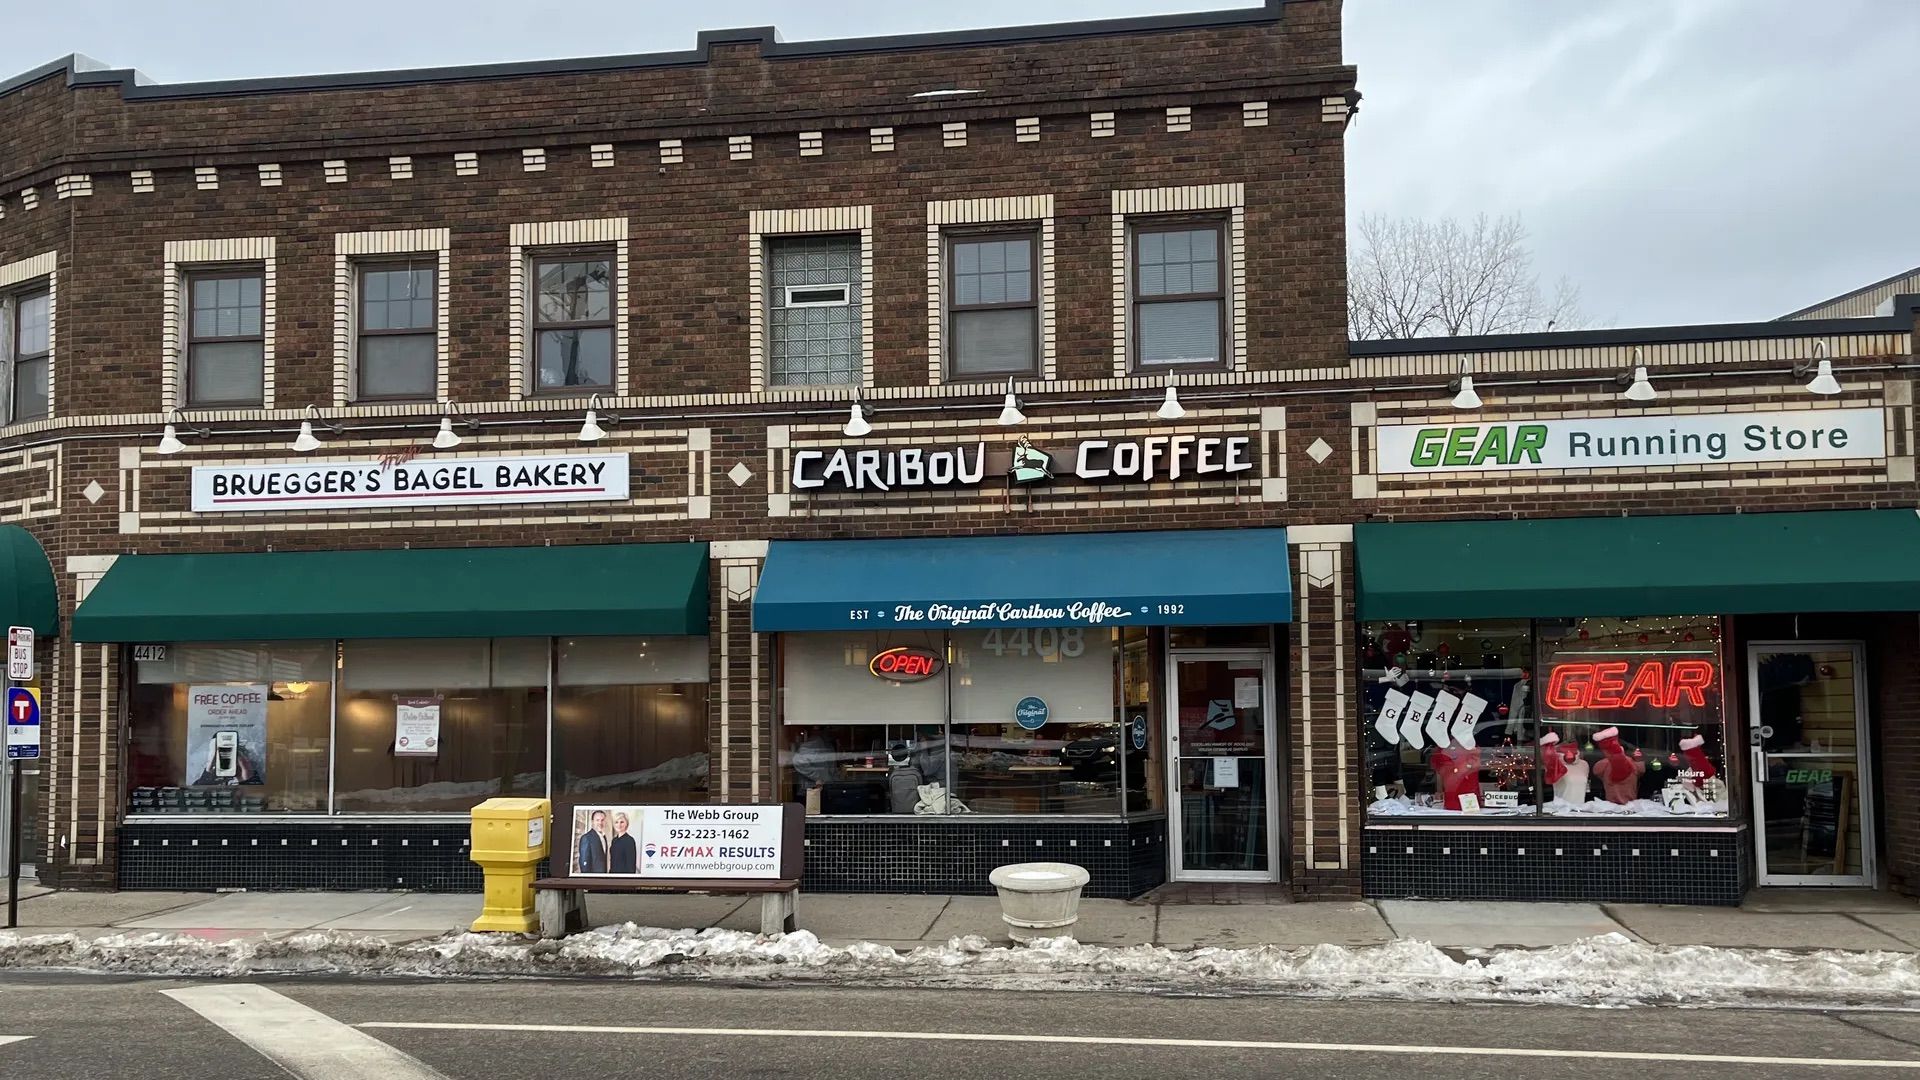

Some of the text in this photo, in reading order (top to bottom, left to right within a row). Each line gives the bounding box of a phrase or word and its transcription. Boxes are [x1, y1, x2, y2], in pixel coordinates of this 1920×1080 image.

[1410, 424, 1848, 467] GEAR Running Store
[792, 435, 1253, 491] CARIBOU COFFEE
[213, 461, 605, 496] BRUEGGER'S BAGEL BAKERY
[850, 601, 1184, 626] EST The Original Caribou Coffee 1992
[981, 628, 1085, 657] 4408
[14, 648, 27, 660] BUS
[134, 646, 165, 660] 4412
[12, 662, 29, 674] STOP
[879, 654, 934, 675] OPEN
[1545, 660, 1714, 710] GEAR
[194, 693, 262, 705] FREE COFFEE
[208, 708, 227, 716] ORDER
[1385, 708, 1474, 725] G E A R
[1677, 769, 1705, 777] Hours
[1785, 769, 1833, 784] GEAR
[664, 809, 759, 822] The Webb Group
[669, 829, 750, 839] 952-223-1462
[660, 846, 776, 858] RE/MAX RESULTS
[660, 861, 775, 872] www.mnwebbgroup.com
